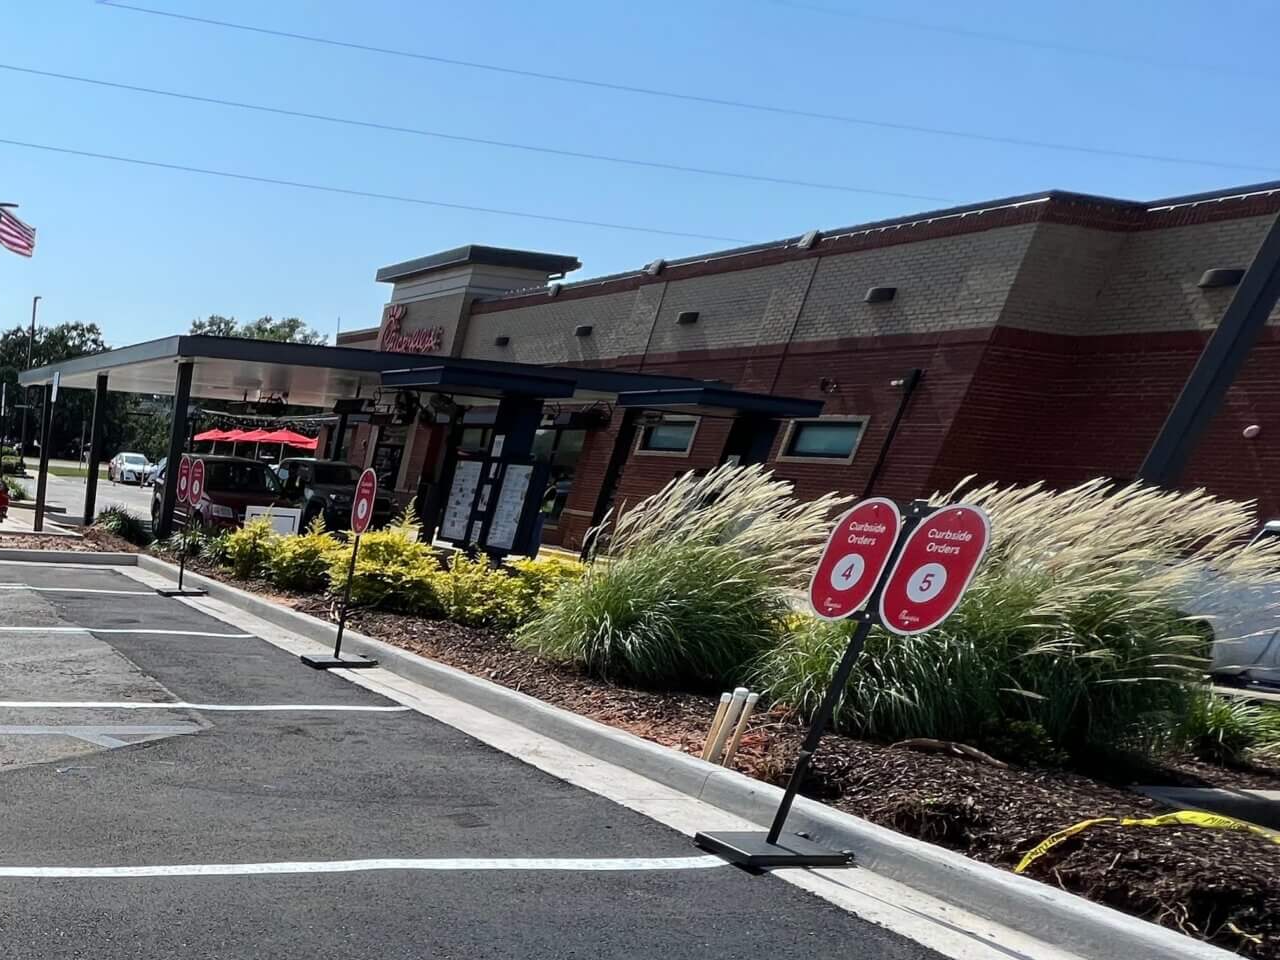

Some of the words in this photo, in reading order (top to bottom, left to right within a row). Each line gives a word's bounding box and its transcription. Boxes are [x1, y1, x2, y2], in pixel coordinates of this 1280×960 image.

[849, 521, 886, 533] Curbside
[847, 534, 877, 546] Orders
[927, 528, 973, 541] Curbside
[926, 542, 960, 554] Orders
[841, 563, 855, 580] 4
[919, 573, 935, 592] 5
